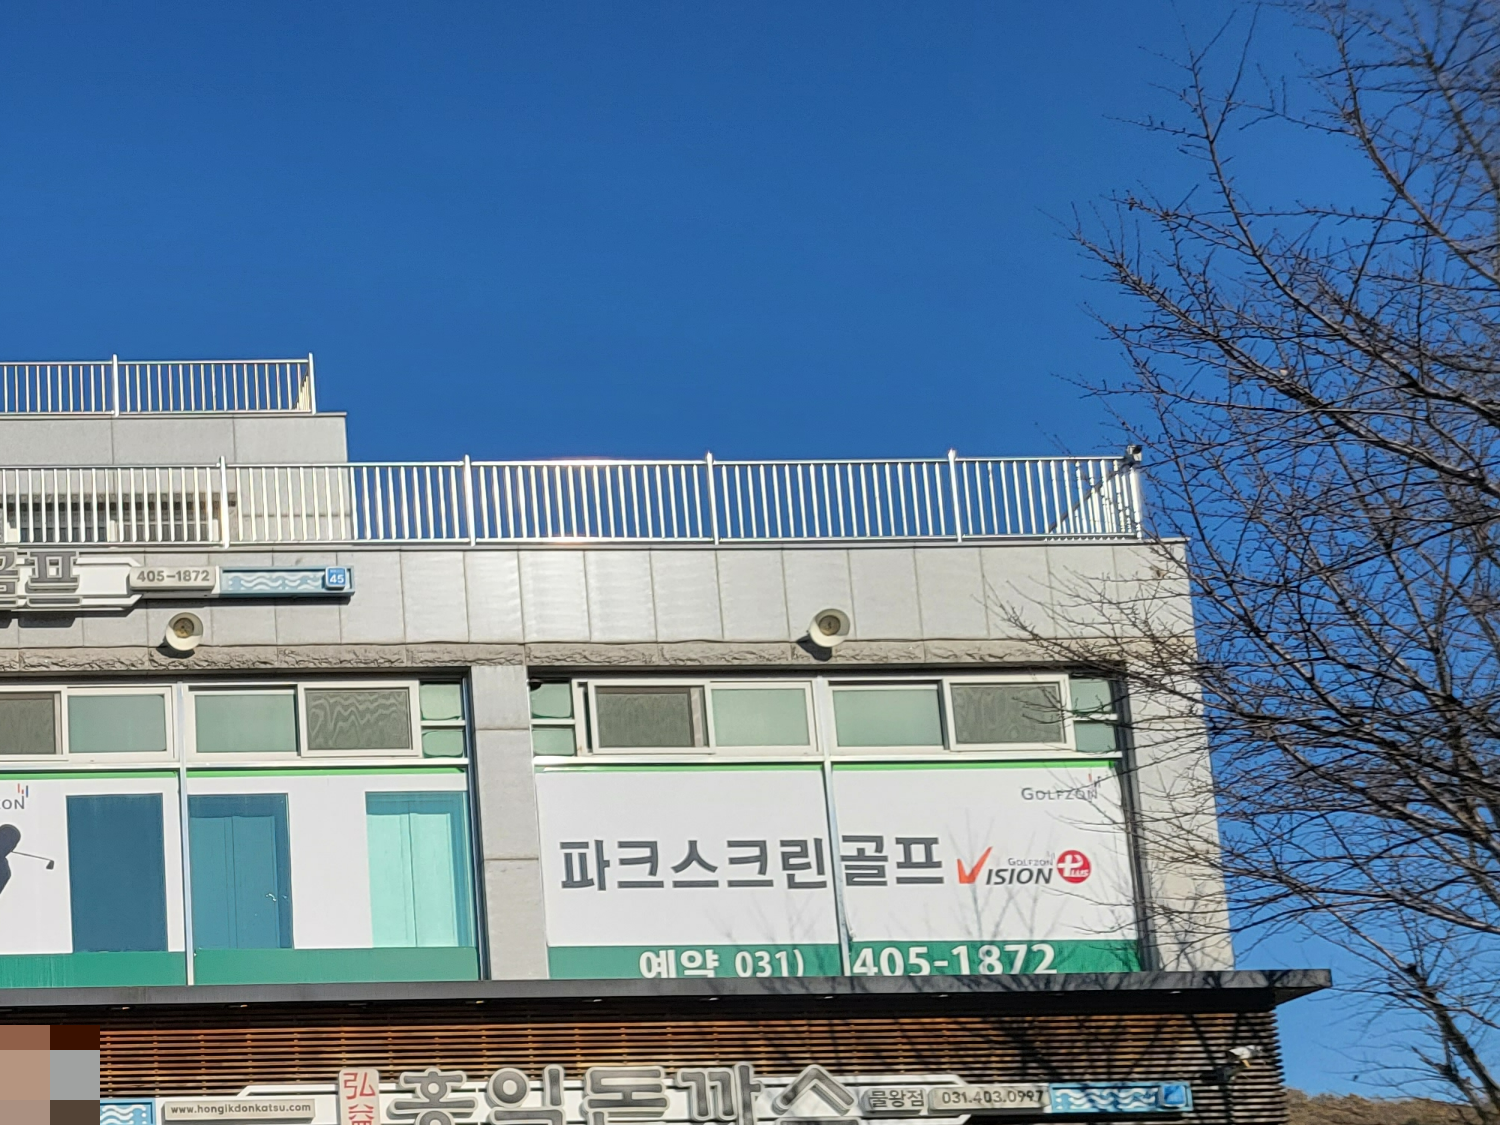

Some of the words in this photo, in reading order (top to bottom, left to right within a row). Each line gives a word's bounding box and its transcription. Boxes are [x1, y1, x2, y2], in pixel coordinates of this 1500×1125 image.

[136, 569, 211, 583] 405-1872
[329, 573, 345, 584] 45
[1021, 787, 1098, 801] GOLFZON
[560, 835, 944, 890] 파크스크린골프
[957, 846, 1053, 885] VISION
[1008, 857, 1053, 867] GOLFZON
[639, 947, 720, 977] 예약
[735, 949, 805, 977] 031)
[853, 943, 1057, 976] 405-1872
[869, 1089, 925, 1108] 물왕점
[942, 1090, 1044, 1104] 031.403.0997
[171, 1103, 311, 1115] www.hongikdonkatsu.com
